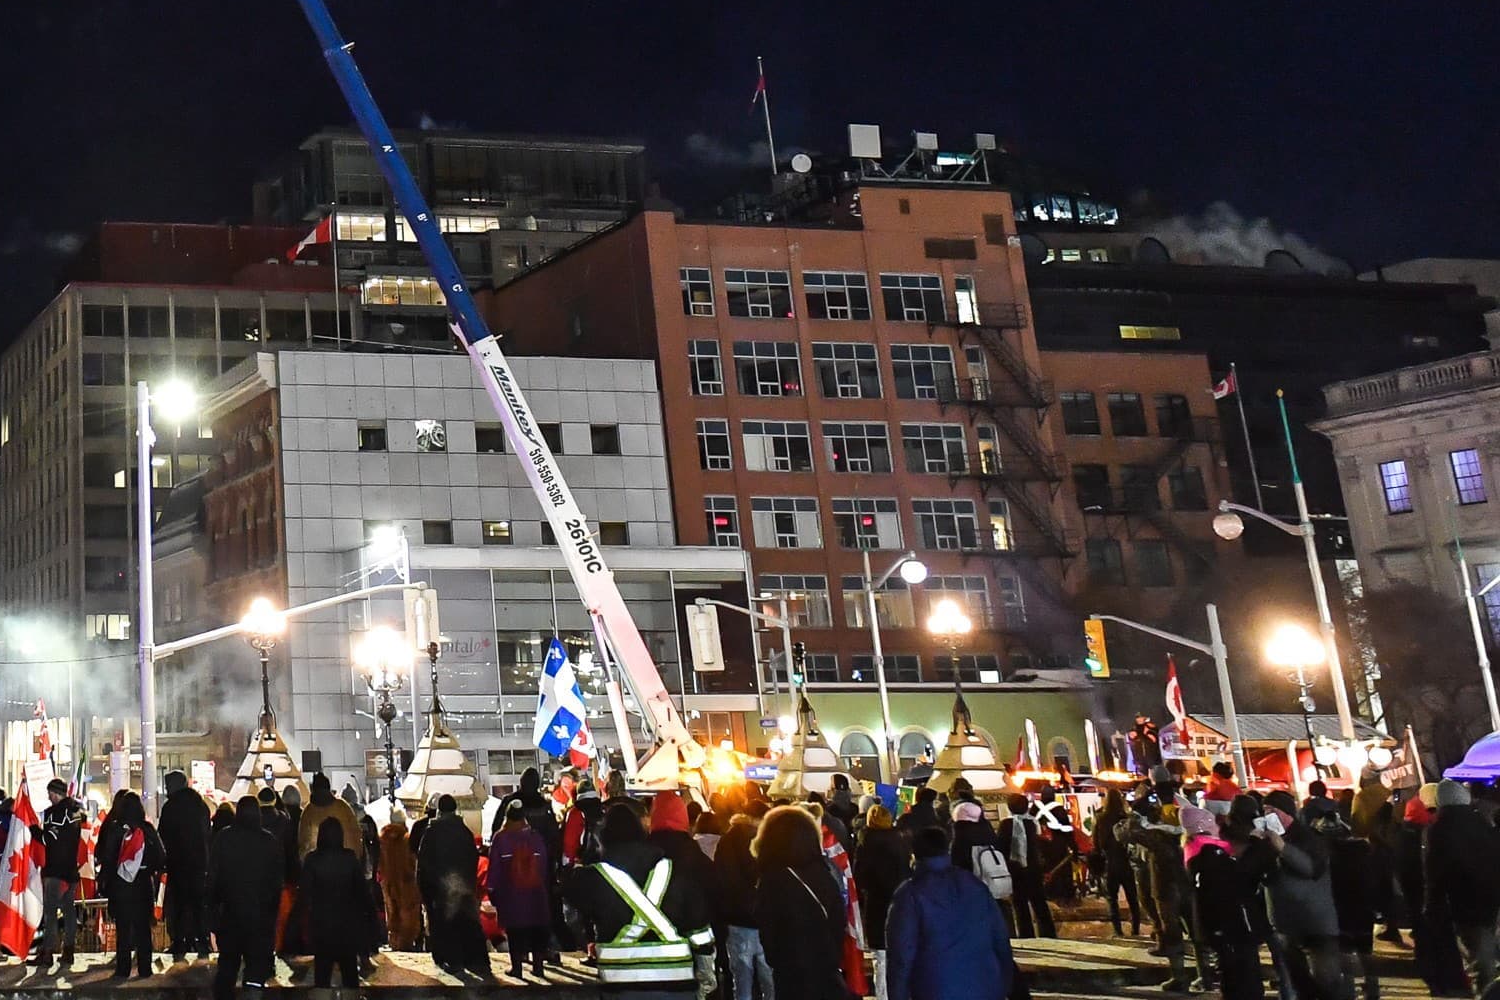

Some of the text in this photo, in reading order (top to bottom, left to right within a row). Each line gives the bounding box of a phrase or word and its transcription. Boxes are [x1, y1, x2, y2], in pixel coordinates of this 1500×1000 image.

[490, 364, 541, 448] Manitex
[529, 448, 566, 508] 519-550-5362
[564, 519, 602, 574] 26101C
